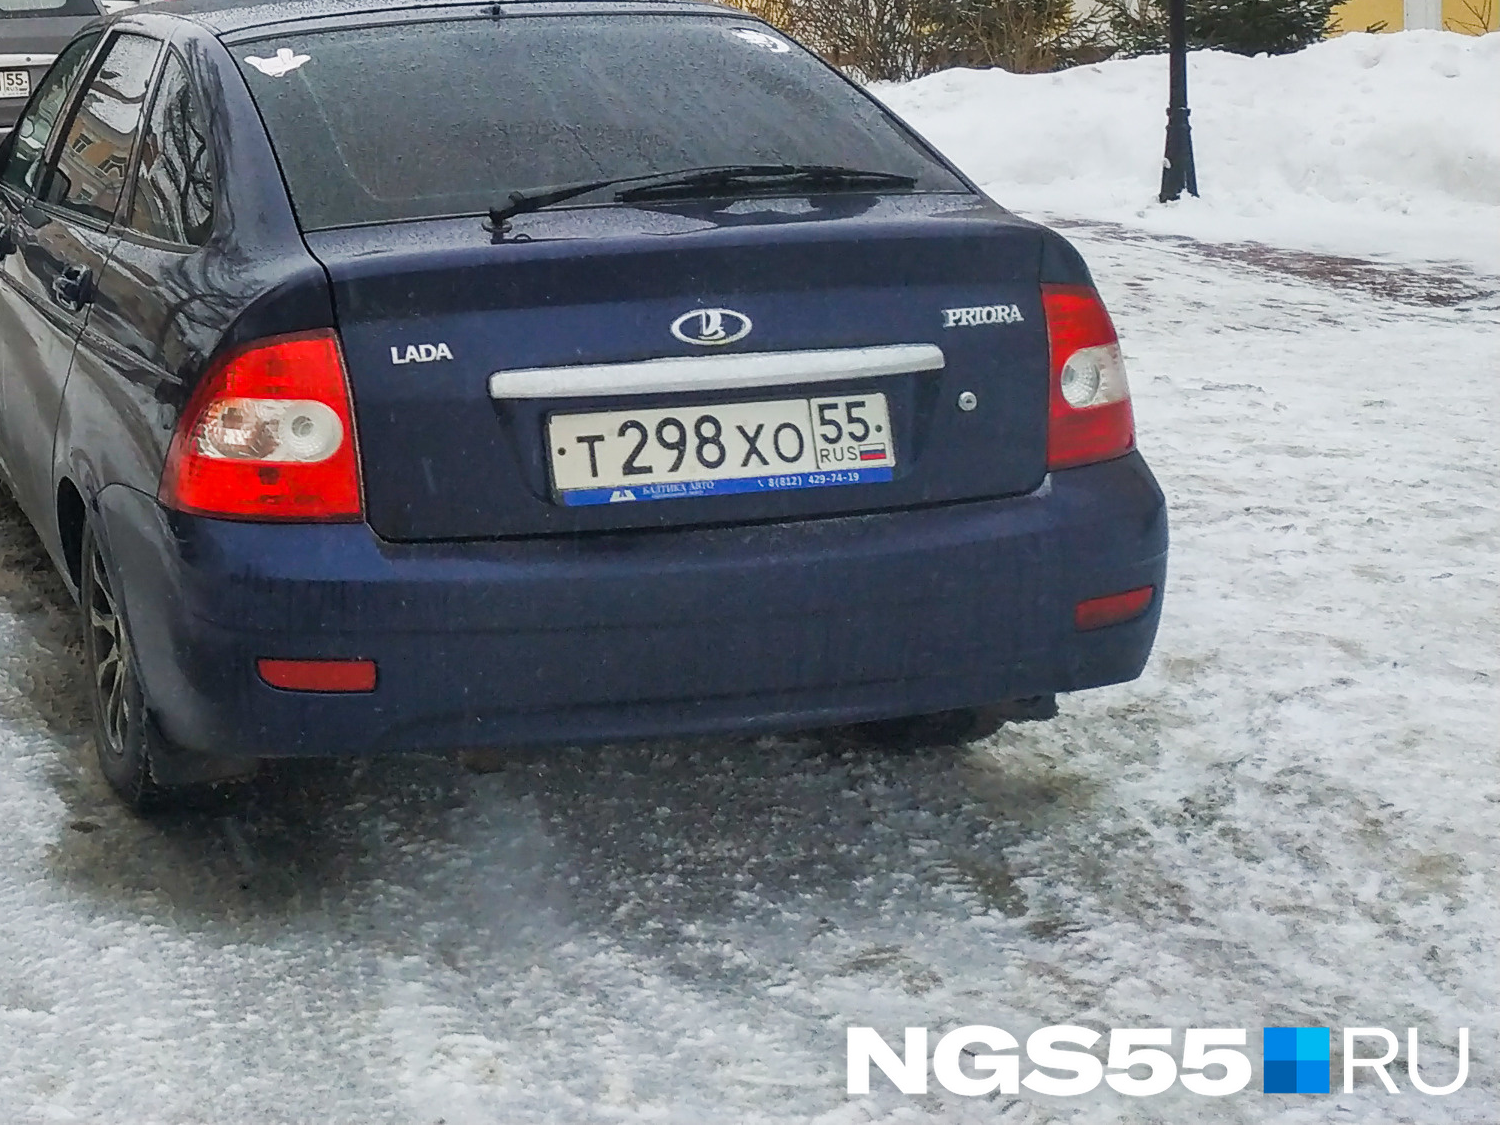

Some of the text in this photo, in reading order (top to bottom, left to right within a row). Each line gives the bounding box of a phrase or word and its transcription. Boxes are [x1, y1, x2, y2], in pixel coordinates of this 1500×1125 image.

[6, 73, 24, 86] 55
[941, 304, 1025, 328] PRIORA
[390, 342, 454, 365] LADA
[575, 400, 871, 478] Т298ХО 55
[819, 445, 858, 464] RUS
[689, 480, 715, 491] АВТО
[767, 472, 860, 488] 8(812) 429-74-19
